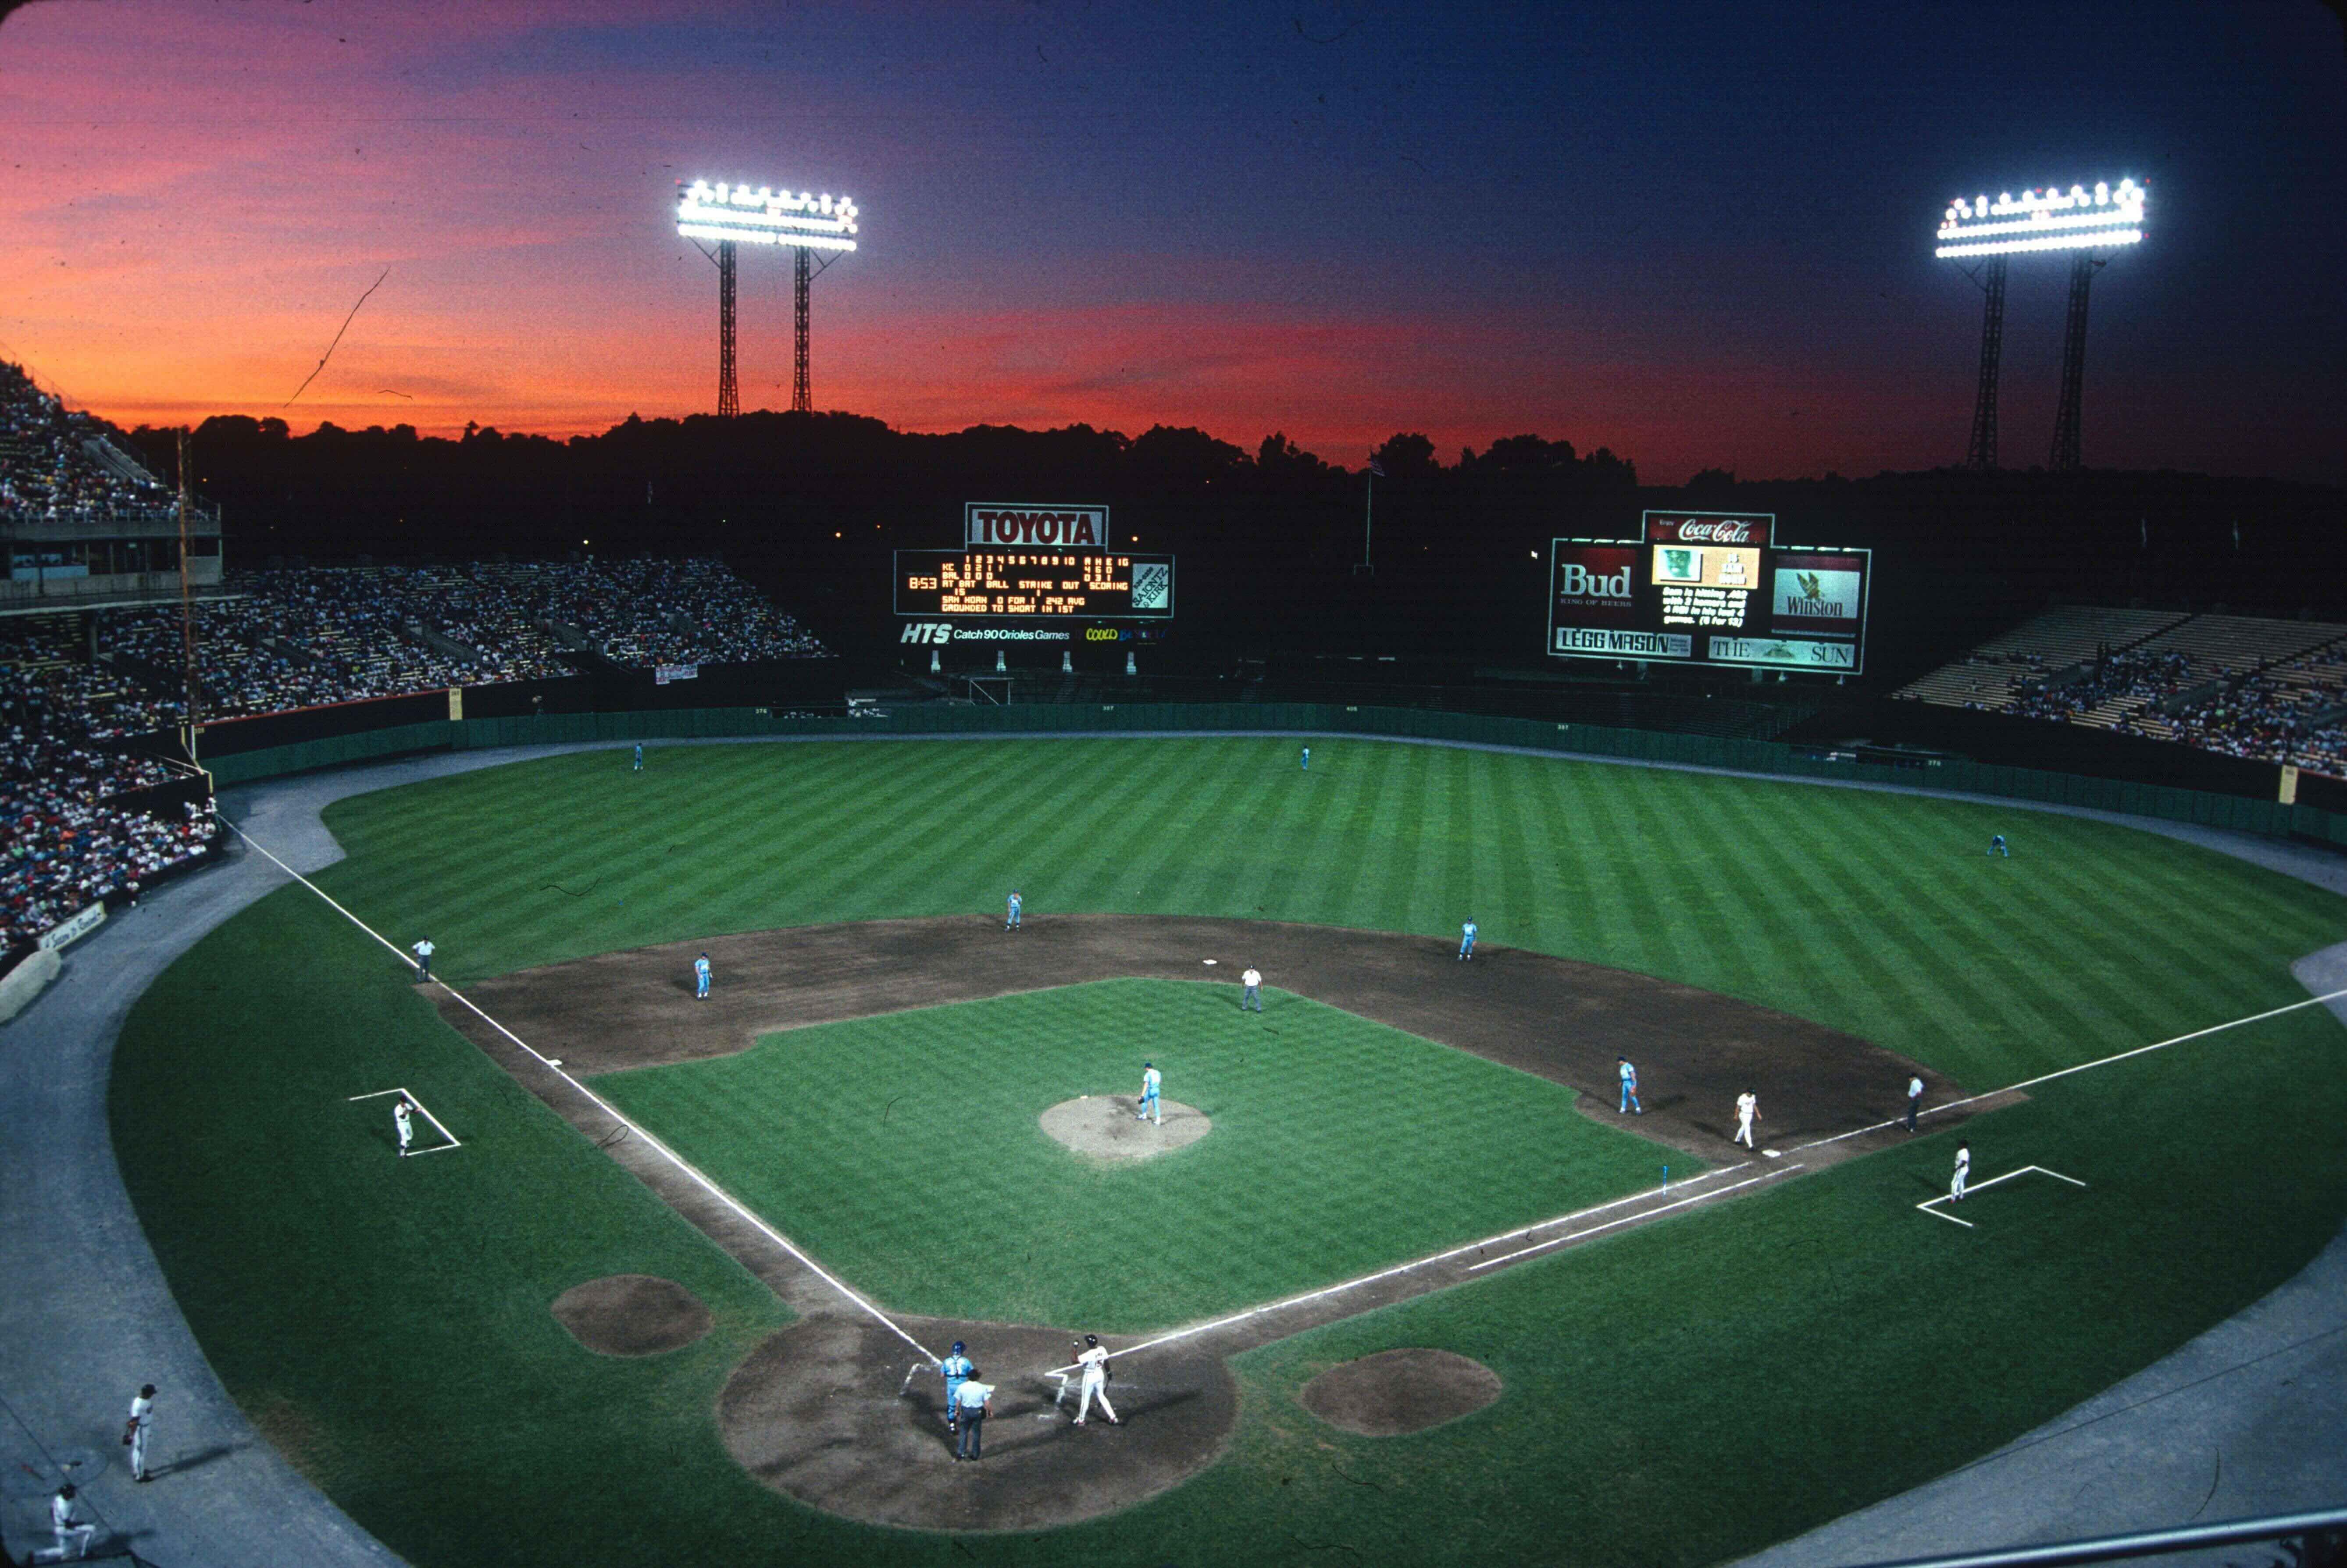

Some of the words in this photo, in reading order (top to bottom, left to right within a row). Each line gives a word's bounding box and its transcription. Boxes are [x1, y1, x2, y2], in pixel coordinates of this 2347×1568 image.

[977, 511, 1096, 545] TOYOTA
[1678, 519, 1753, 543] Coca-Cola
[966, 555, 970, 563] 1
[975, 555, 982, 564] 2
[986, 555, 993, 564] 3
[997, 556, 1004, 564] 4
[1008, 556, 1015, 564] 5
[1019, 556, 1026, 565] 6
[1031, 556, 1037, 565] 7
[1041, 556, 1048, 565] 8
[1052, 556, 1059, 565] 9
[1064, 556, 1075, 565] 10
[909, 577, 937, 589] 8:53
[1089, 582, 1128, 590] SCORING
[1131, 567, 1168, 606] SAIONTZ
[1561, 563, 1632, 598] Bud
[1067, 597, 1085, 606] AVG
[1146, 581, 1168, 603] KIRK
[1787, 596, 1843, 617] Winston
[900, 623, 952, 644] HTS
[954, 629, 983, 639] Catch
[984, 629, 999, 640] 90
[999, 629, 1034, 640] Orioles
[1035, 630, 1070, 640] Games
[1085, 627, 1118, 641] COULD
[1562, 630, 1605, 649] LEGG
[1608, 633, 1669, 654] MASON
[1713, 641, 1750, 658] THE
[1811, 646, 1849, 663] SUN
